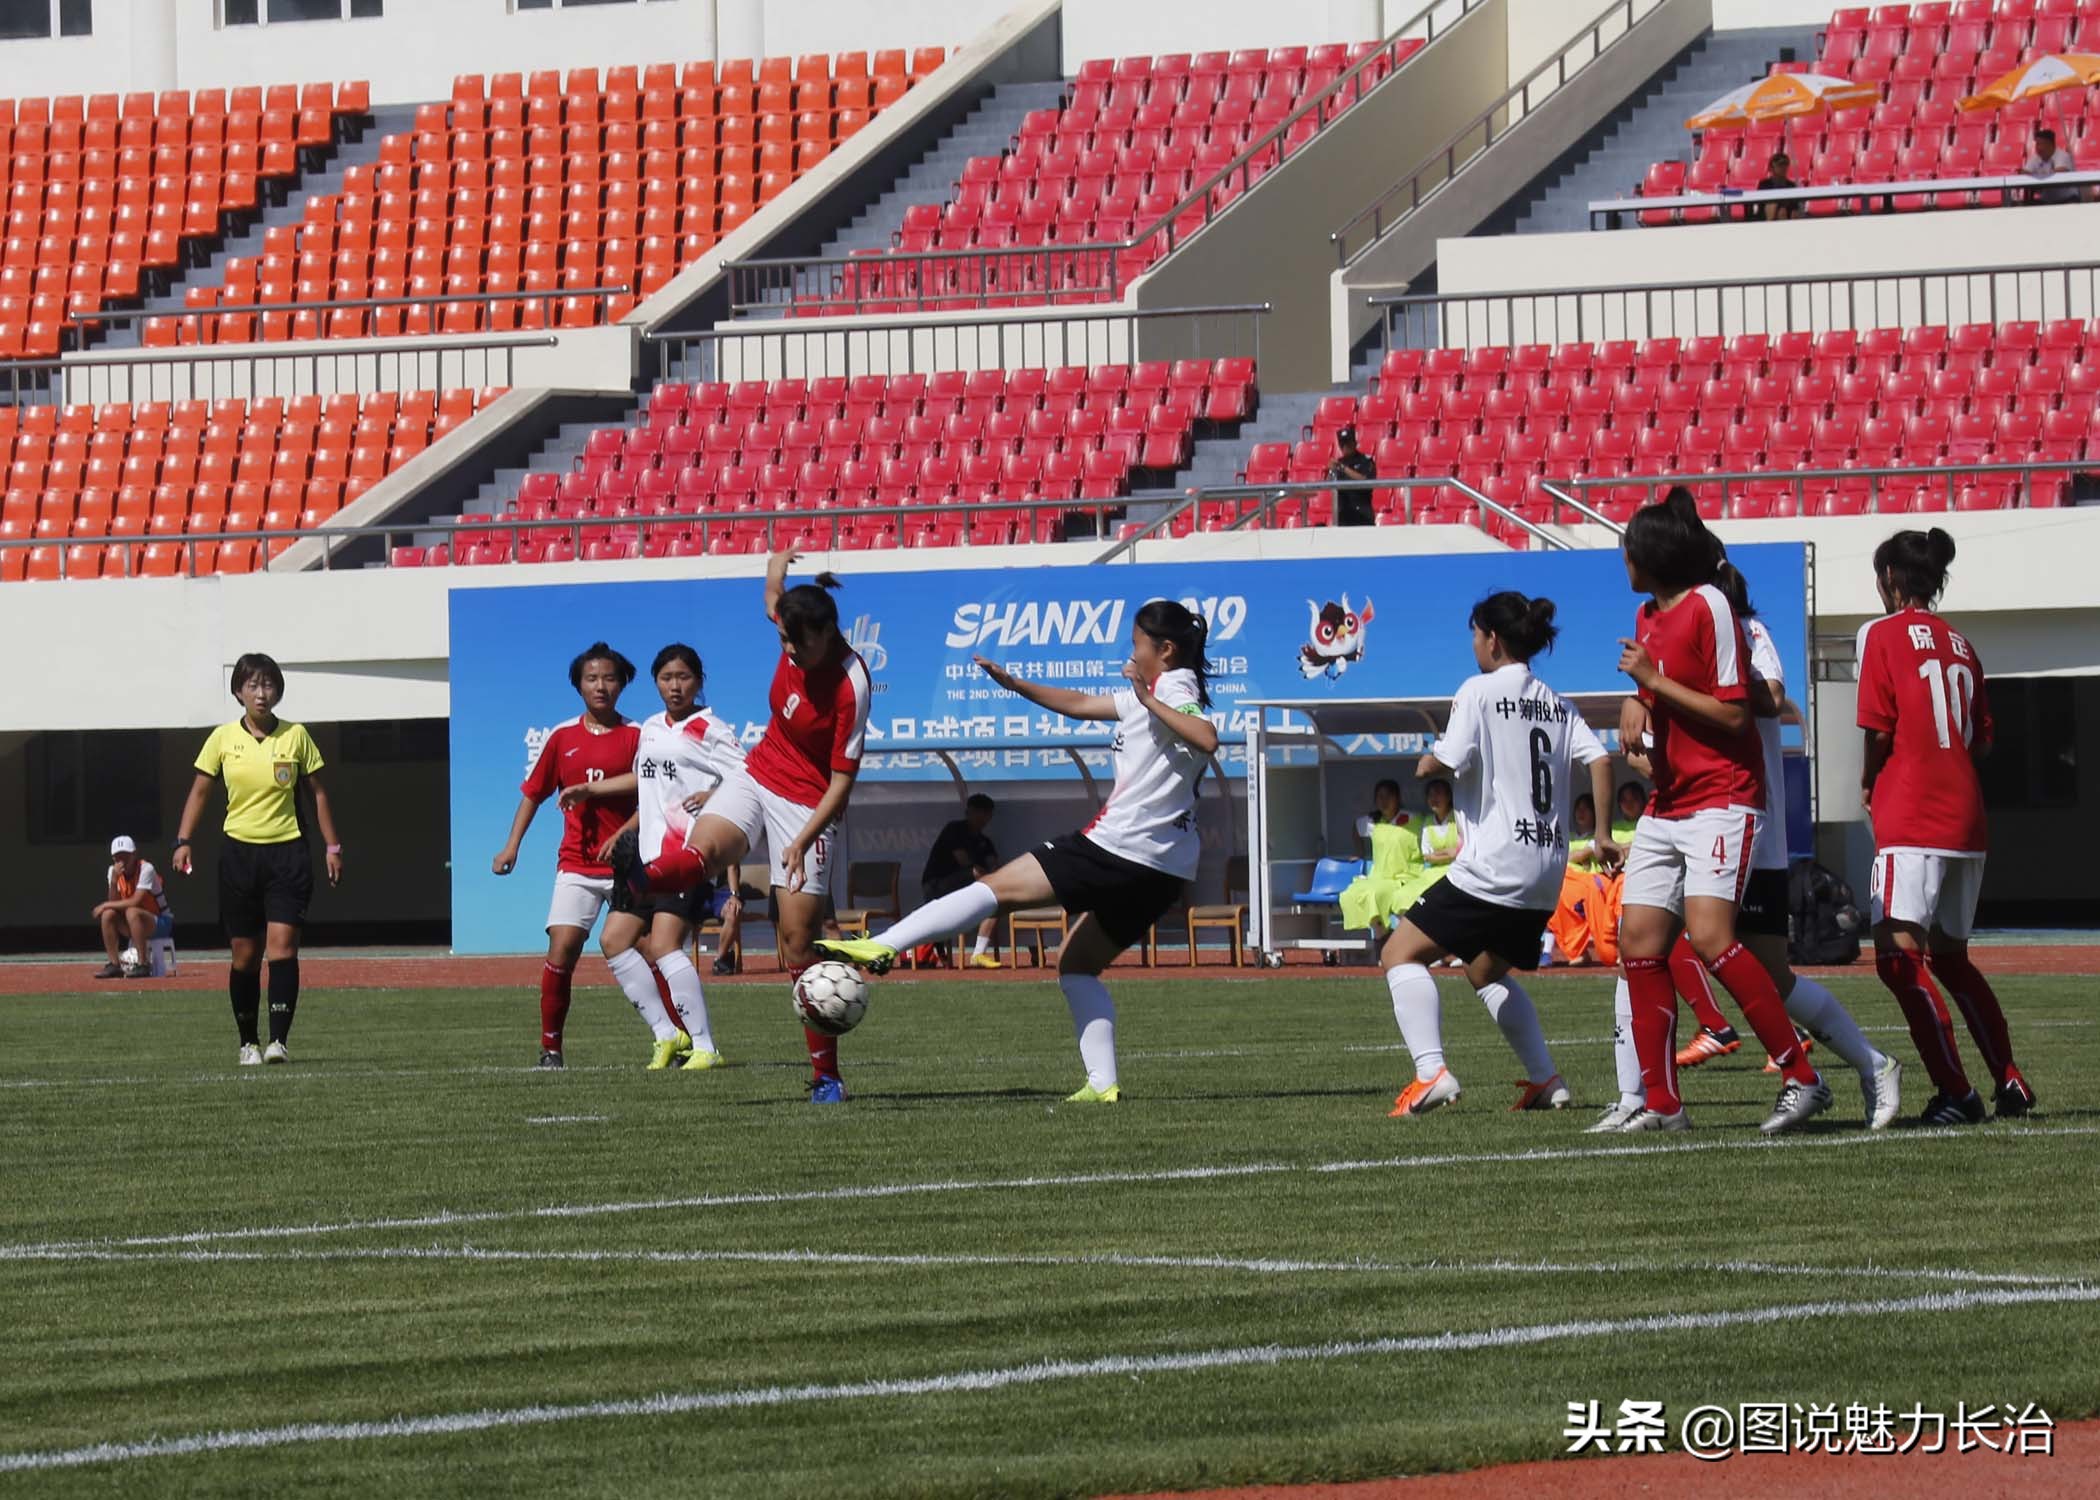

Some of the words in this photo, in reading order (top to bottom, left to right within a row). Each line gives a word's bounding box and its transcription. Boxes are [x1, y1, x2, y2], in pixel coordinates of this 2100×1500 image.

[945, 600, 1125, 648] SHANXI
[1142, 596, 1247, 641] 19
[1908, 624, 1970, 661] 保定
[782, 692, 801, 720] 9
[946, 689, 966, 700] THE
[969, 689, 990, 700] 2ND
[1215, 683, 1247, 694] CHINA
[1918, 658, 1974, 750] 10
[641, 757, 677, 781] 金华
[1529, 727, 1552, 815] 6
[815, 838, 827, 865] 9
[1712, 835, 1727, 865] 4
